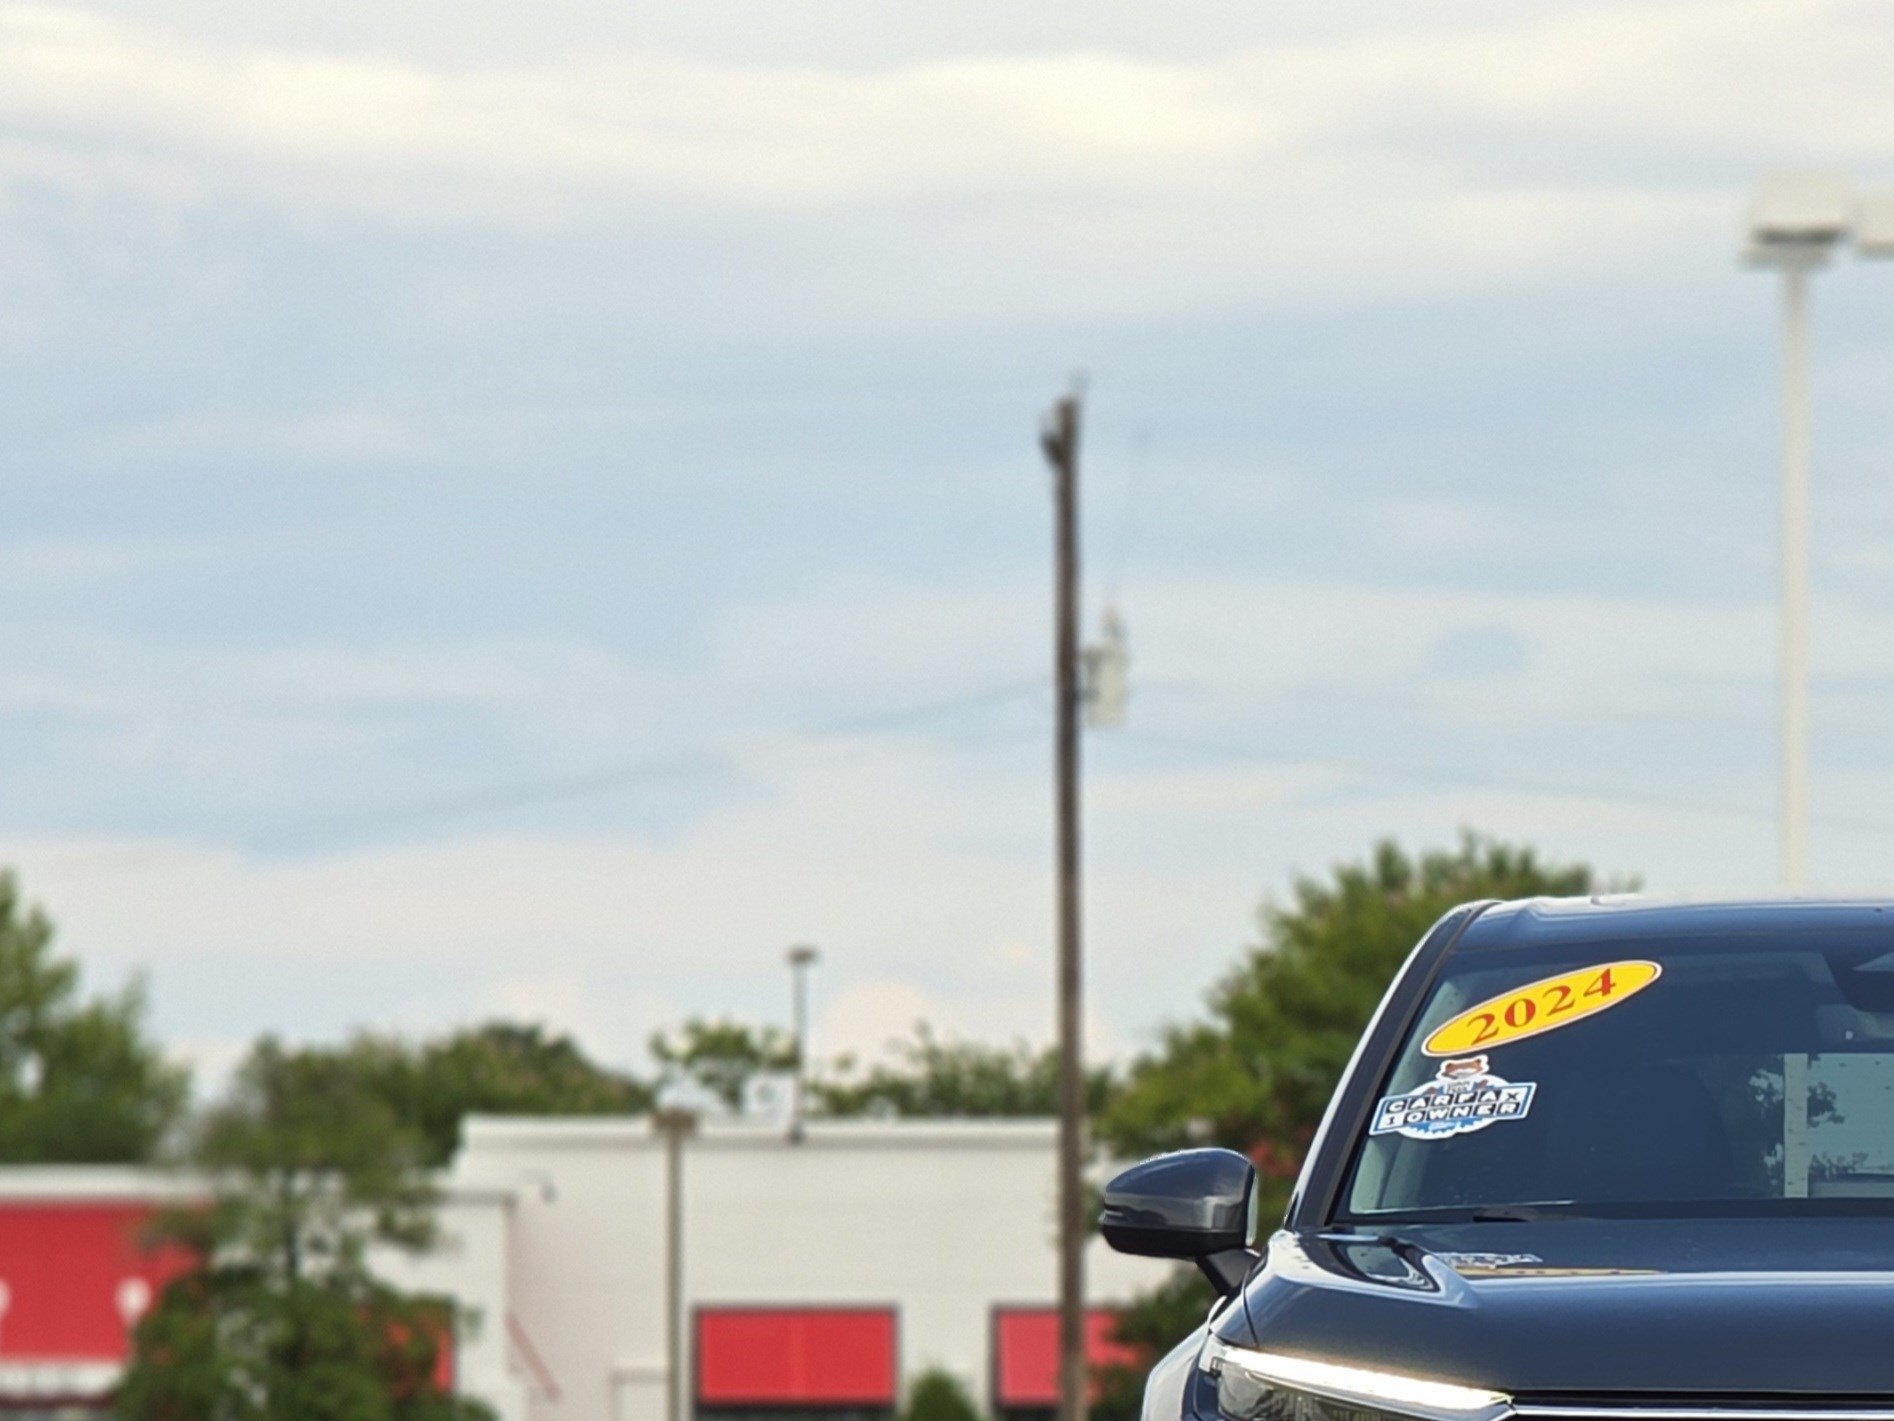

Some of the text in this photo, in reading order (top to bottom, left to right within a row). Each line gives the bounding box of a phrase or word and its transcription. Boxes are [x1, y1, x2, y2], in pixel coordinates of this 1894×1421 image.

[1466, 968, 1616, 1046] 2024
[1388, 1091, 1521, 1113] CARFAX
[1406, 1102, 1518, 1123] OWNER
